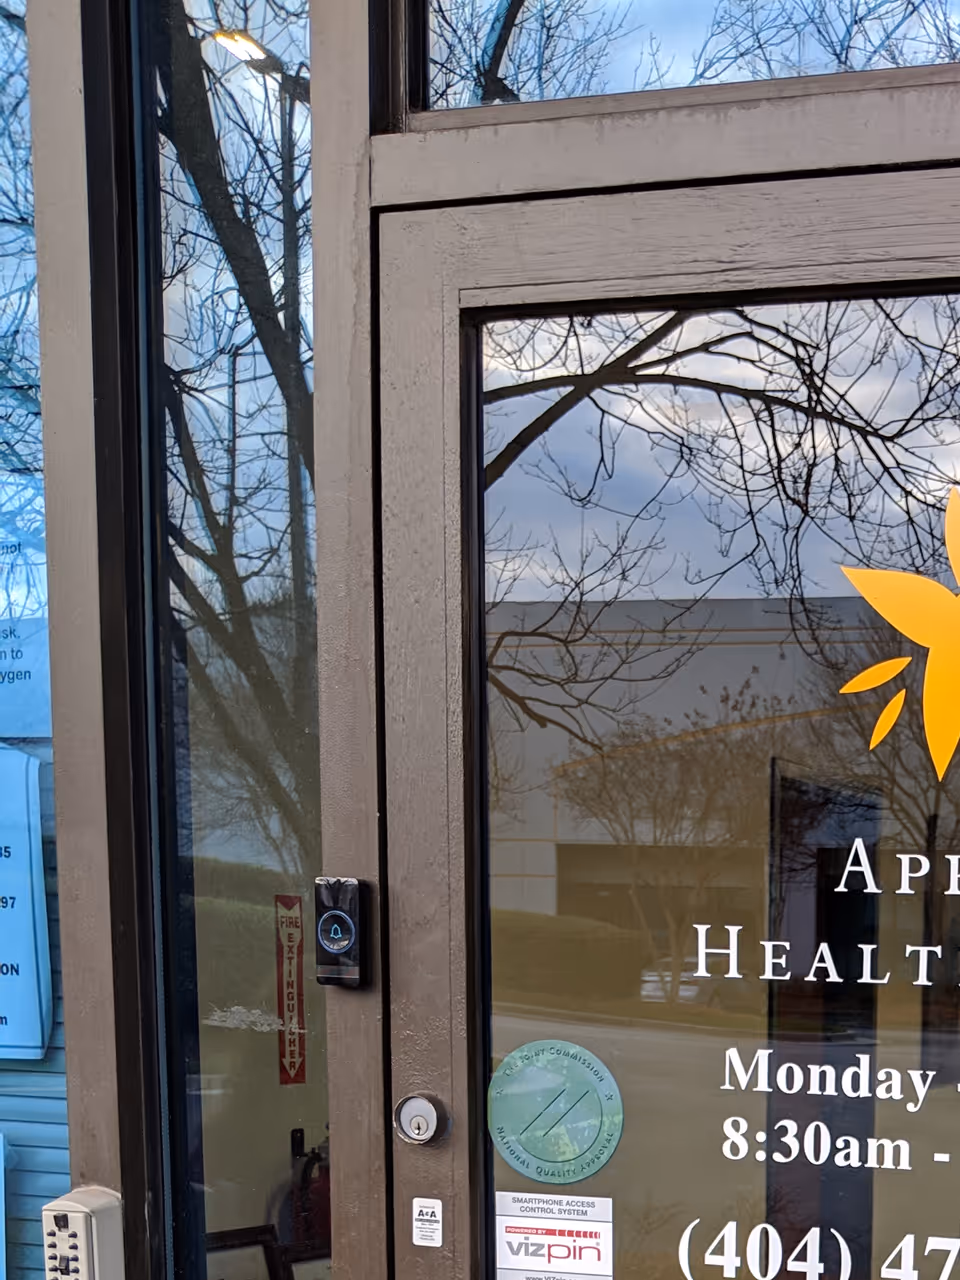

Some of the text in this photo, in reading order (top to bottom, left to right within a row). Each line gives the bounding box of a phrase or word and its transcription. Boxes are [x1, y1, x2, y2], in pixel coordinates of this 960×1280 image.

[1, 625, 21, 639] sk.
[11, 648, 24, 660] to
[0, 670, 31, 684] ygen
[0, 896, 17, 909] 97
[280, 916, 300, 929] FIRE
[0, 962, 20, 976] ON
[549, 1047, 605, 1083] COMMISSION
[720, 1047, 936, 1113] Monday
[721, 1116, 912, 1171] 8:30am
[933, 1150, 951, 1163] -
[496, 1126, 614, 1178] NATIONAL QUALITY APPROVAL
[512, 1196, 596, 1209] SMARTPHONE ACCESS
[519, 1206, 588, 1217] CONTROL SYSTEM
[506, 1227, 537, 1235] POWERED
